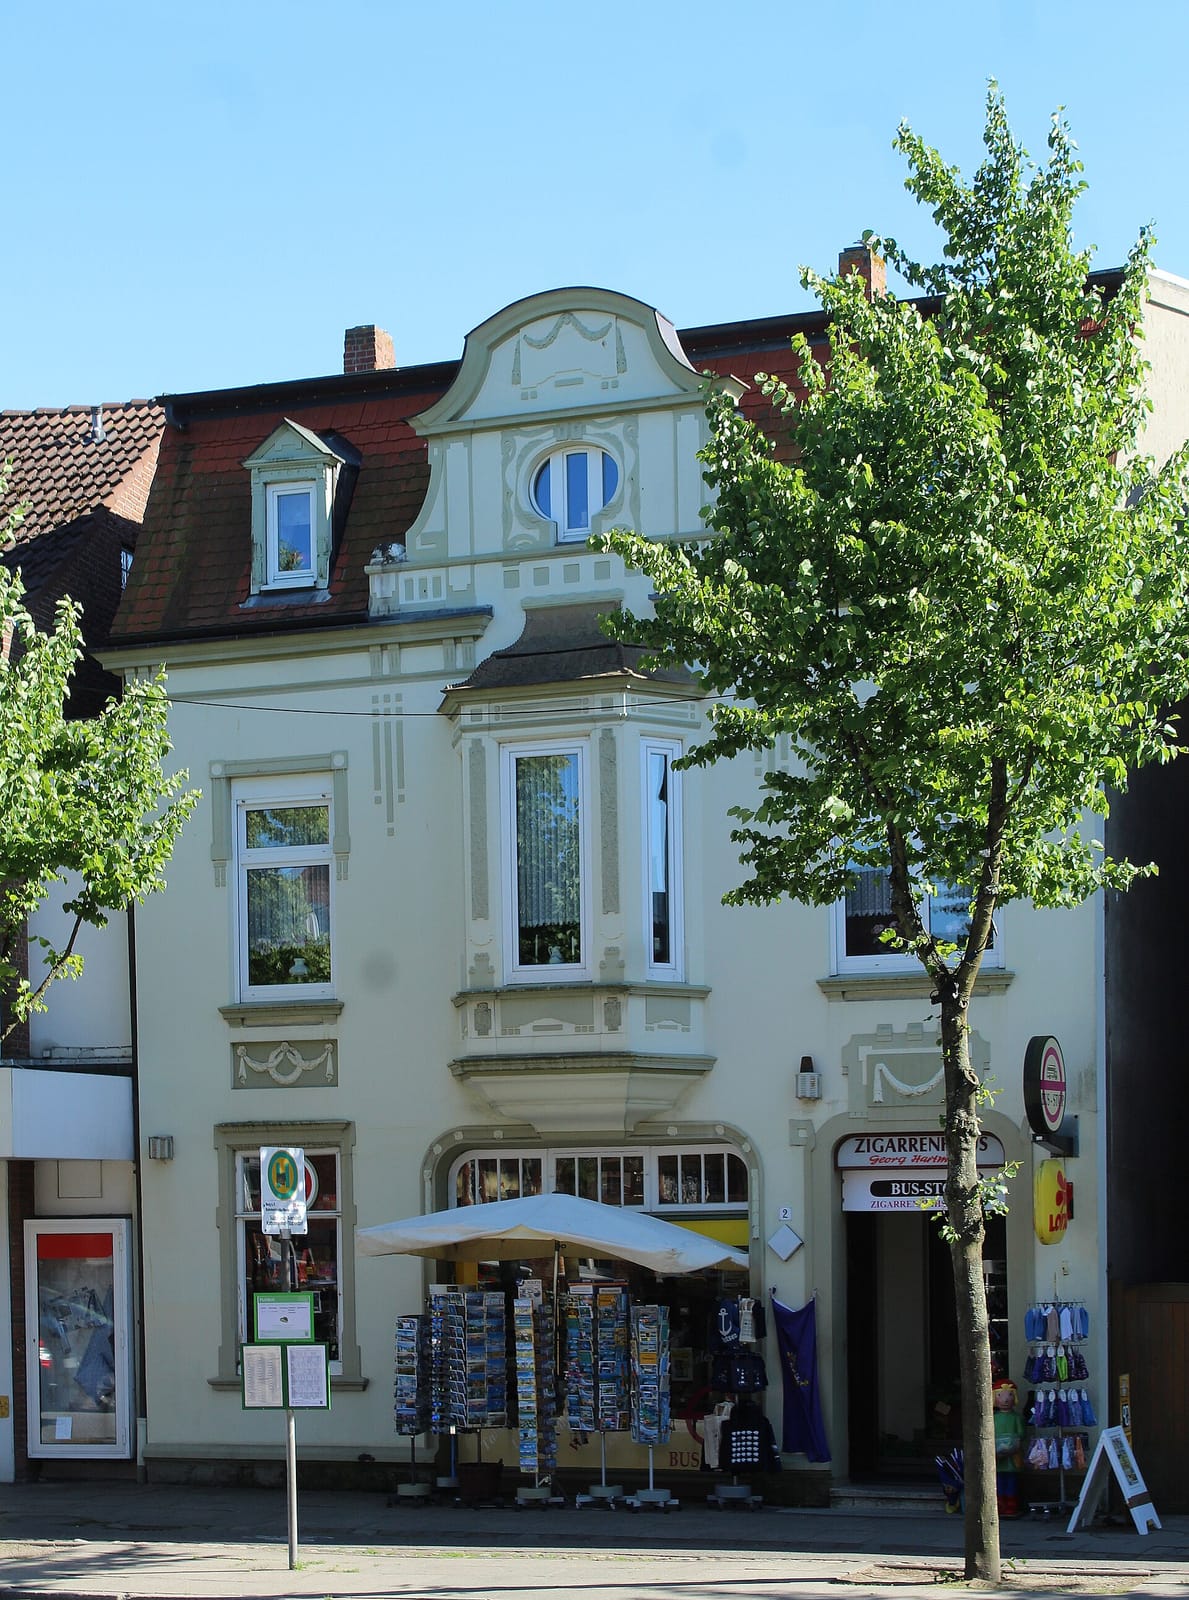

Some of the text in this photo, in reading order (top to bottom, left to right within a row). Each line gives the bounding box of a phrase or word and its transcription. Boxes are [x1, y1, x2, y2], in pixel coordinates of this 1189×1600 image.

[855, 1136, 988, 1153] ZIGARRENS
[869, 1154, 949, 1165] Georg Hartm
[276, 1162, 290, 1188] H
[782, 1208, 789, 1219] 2
[669, 1451, 700, 1467] BUS
